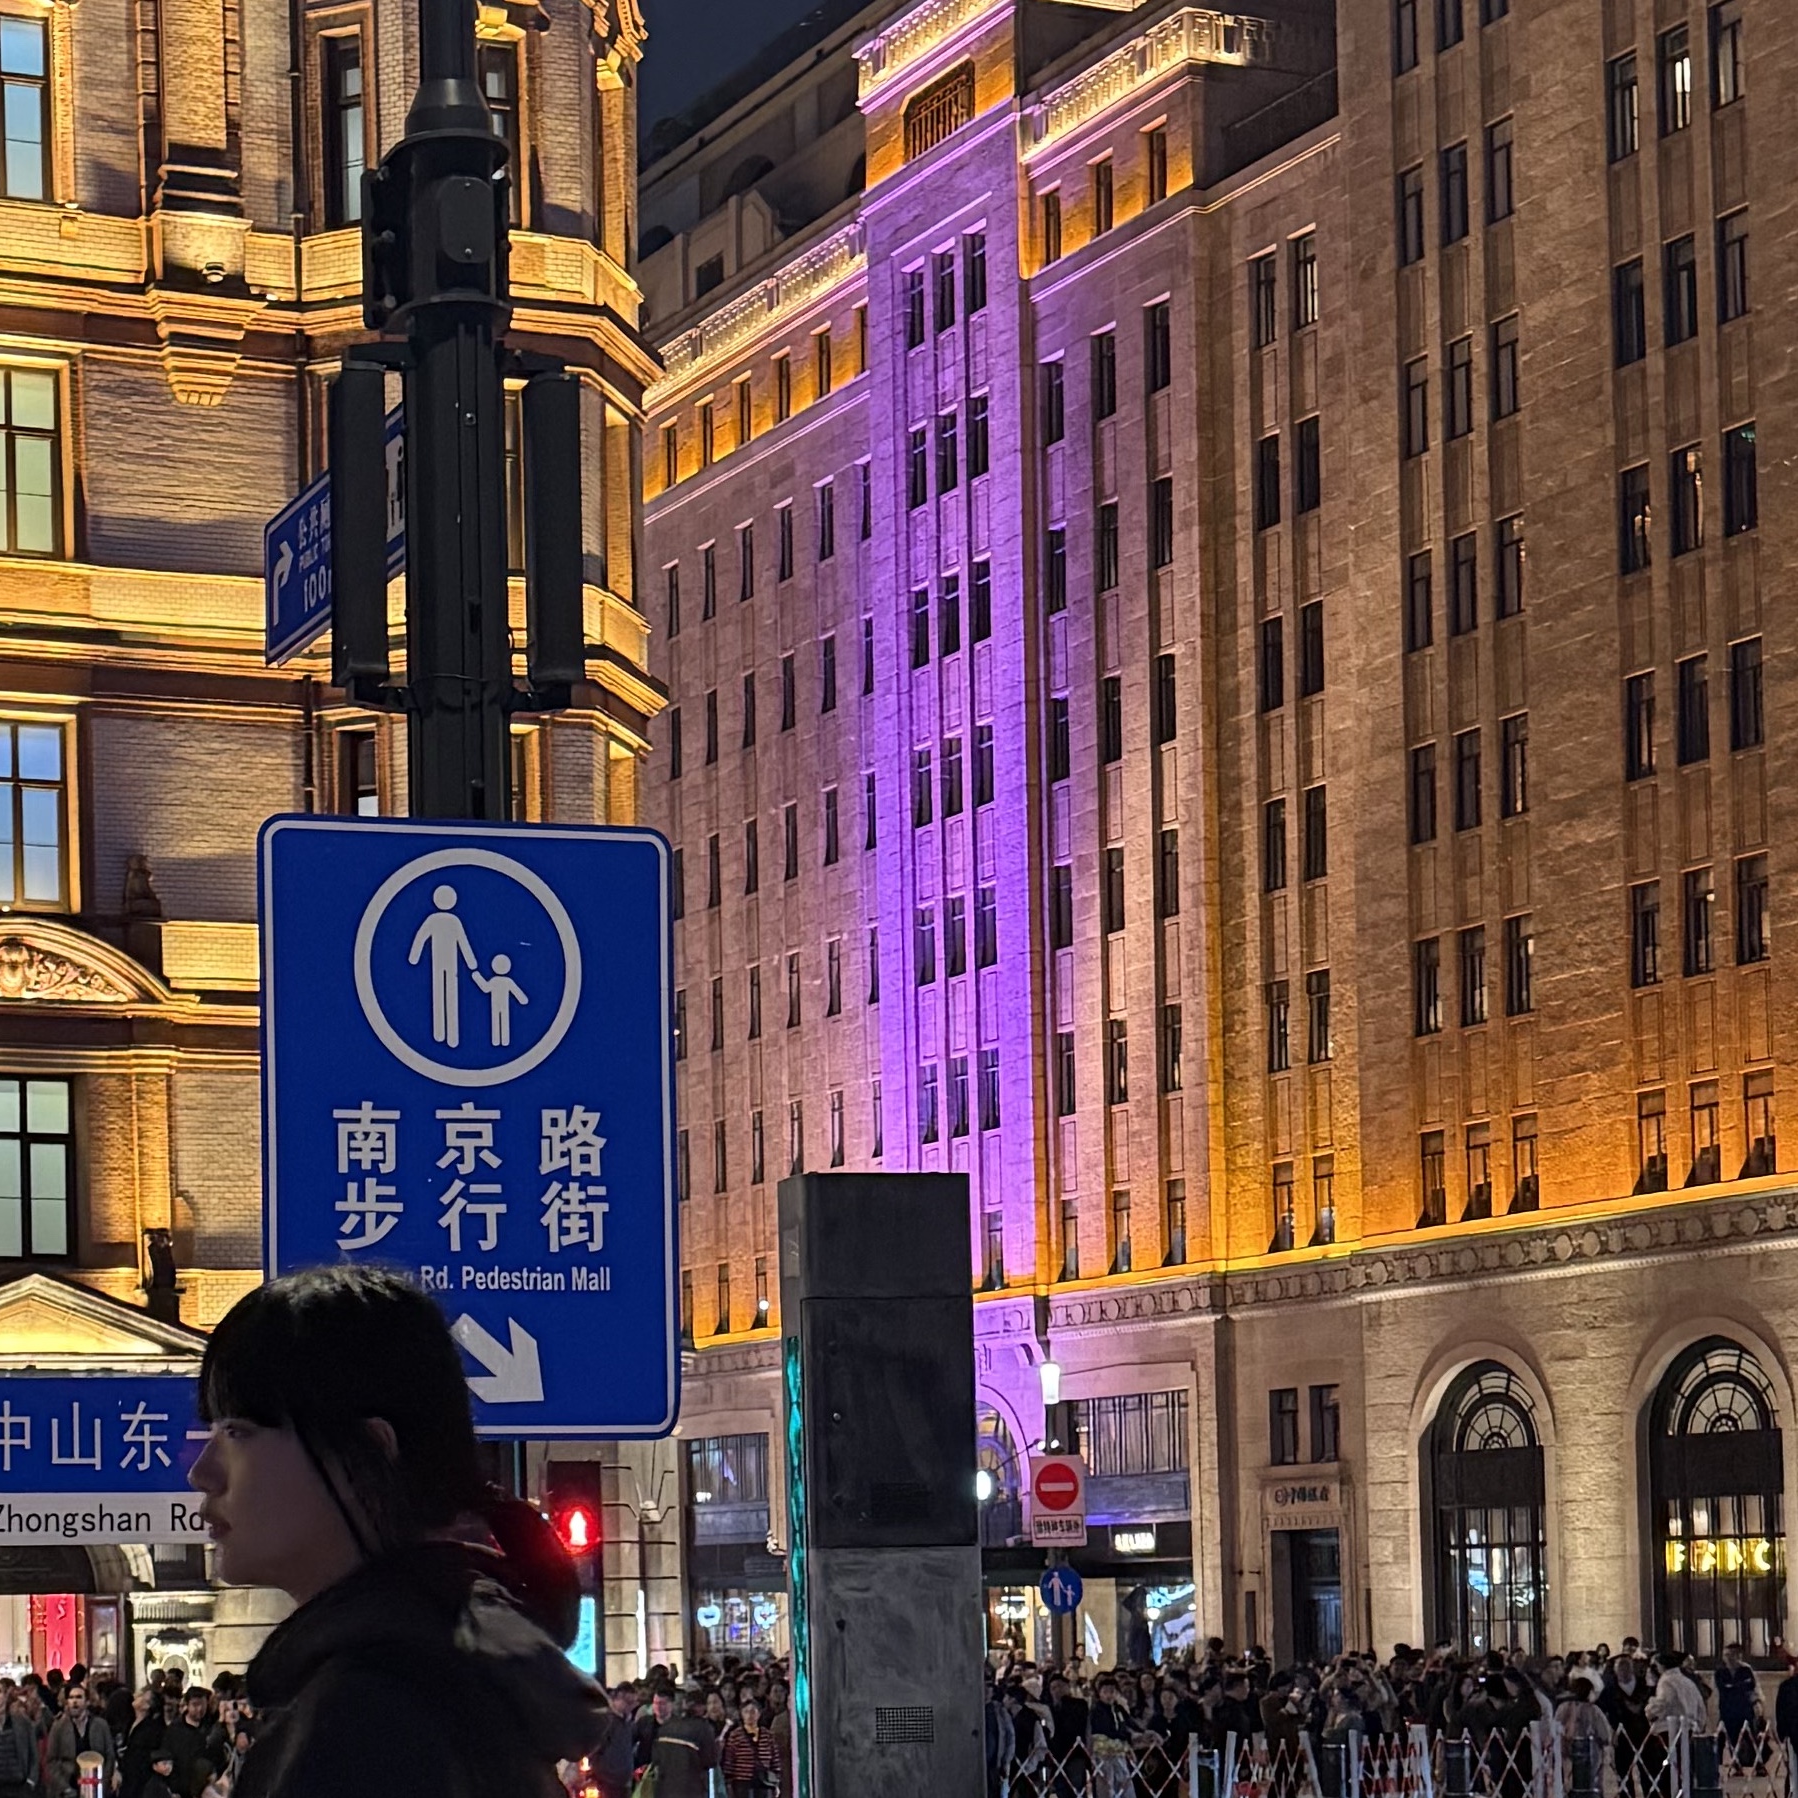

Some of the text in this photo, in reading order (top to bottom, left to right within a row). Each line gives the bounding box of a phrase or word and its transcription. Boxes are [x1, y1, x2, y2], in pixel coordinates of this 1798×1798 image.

[332, 1100, 607, 1177] 南京路
[334, 1177, 610, 1253] 步行街
[420, 1265, 454, 1291] Rd.
[462, 1266, 565, 1291] Pedestrian
[571, 1266, 611, 1291] Mall
